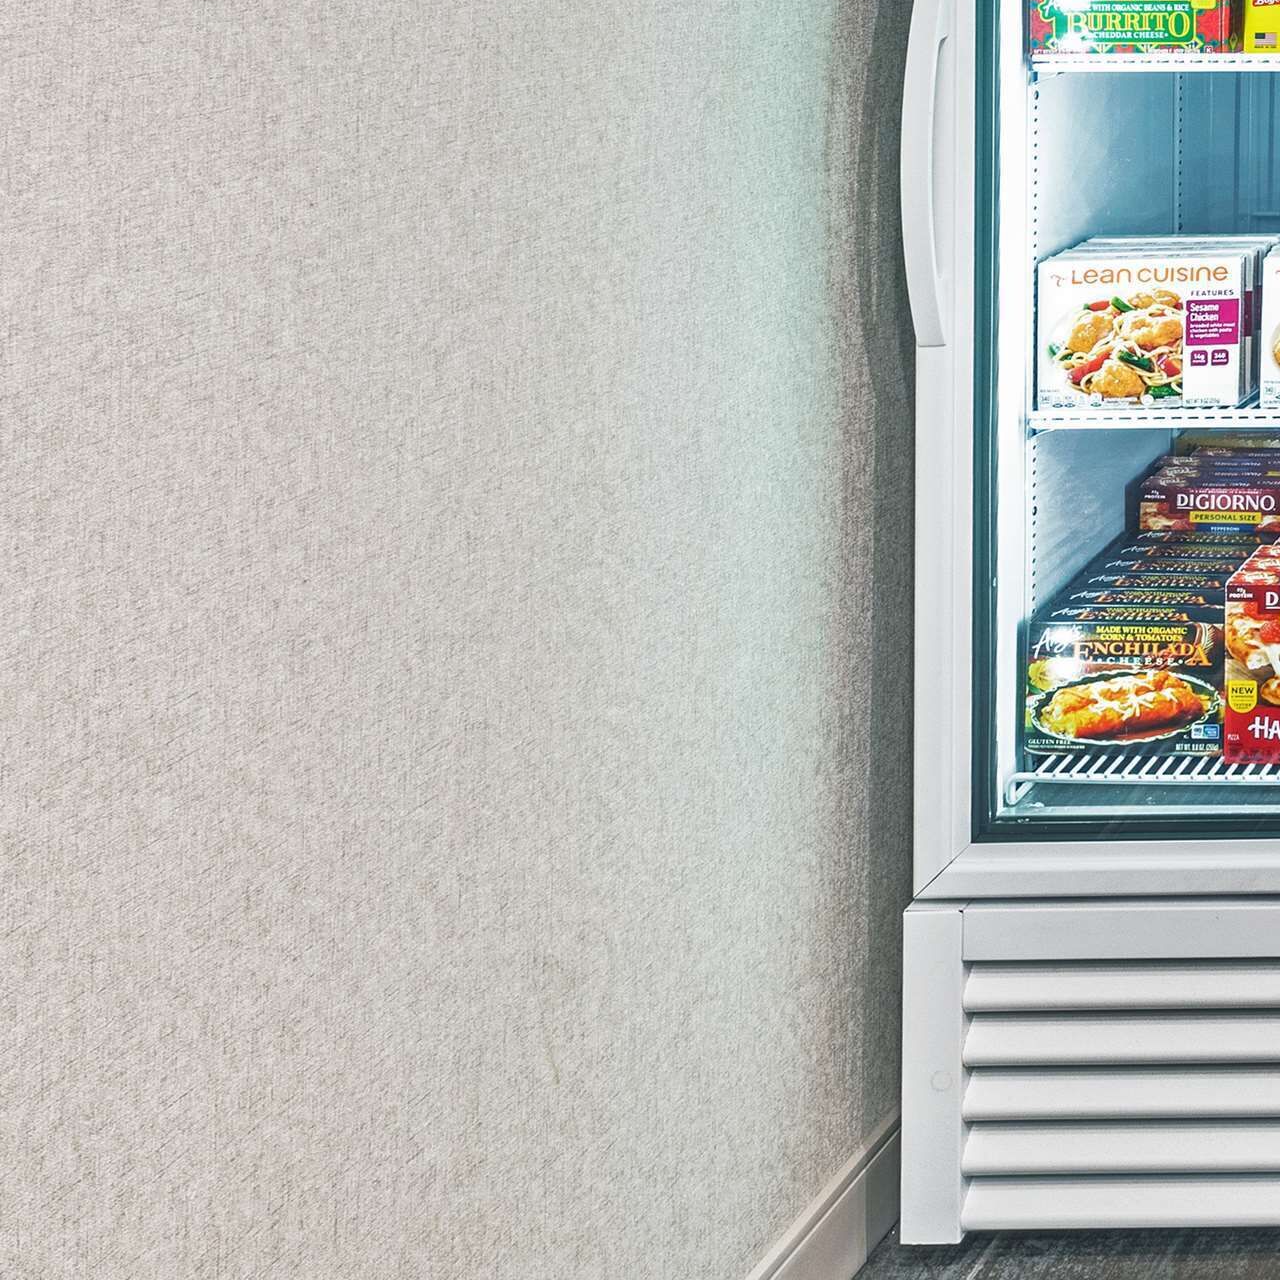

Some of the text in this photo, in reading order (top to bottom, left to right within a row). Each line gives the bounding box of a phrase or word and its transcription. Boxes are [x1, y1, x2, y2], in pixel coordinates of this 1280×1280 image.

[1067, 11, 1190, 37] BURRITO
[1190, 289, 1235, 297] FEATURES
[1190, 303, 1219, 312] Sesame
[1190, 312, 1219, 321] Chicken
[1096, 626, 1188, 635] MADE WITH ORGANIC
[1100, 633, 1183, 642] CORN TOMATOES
[1073, 640, 1212, 667] ENCHILADA
[1103, 657, 1178, 665] CHEESE
[1231, 686, 1254, 695] NEW
